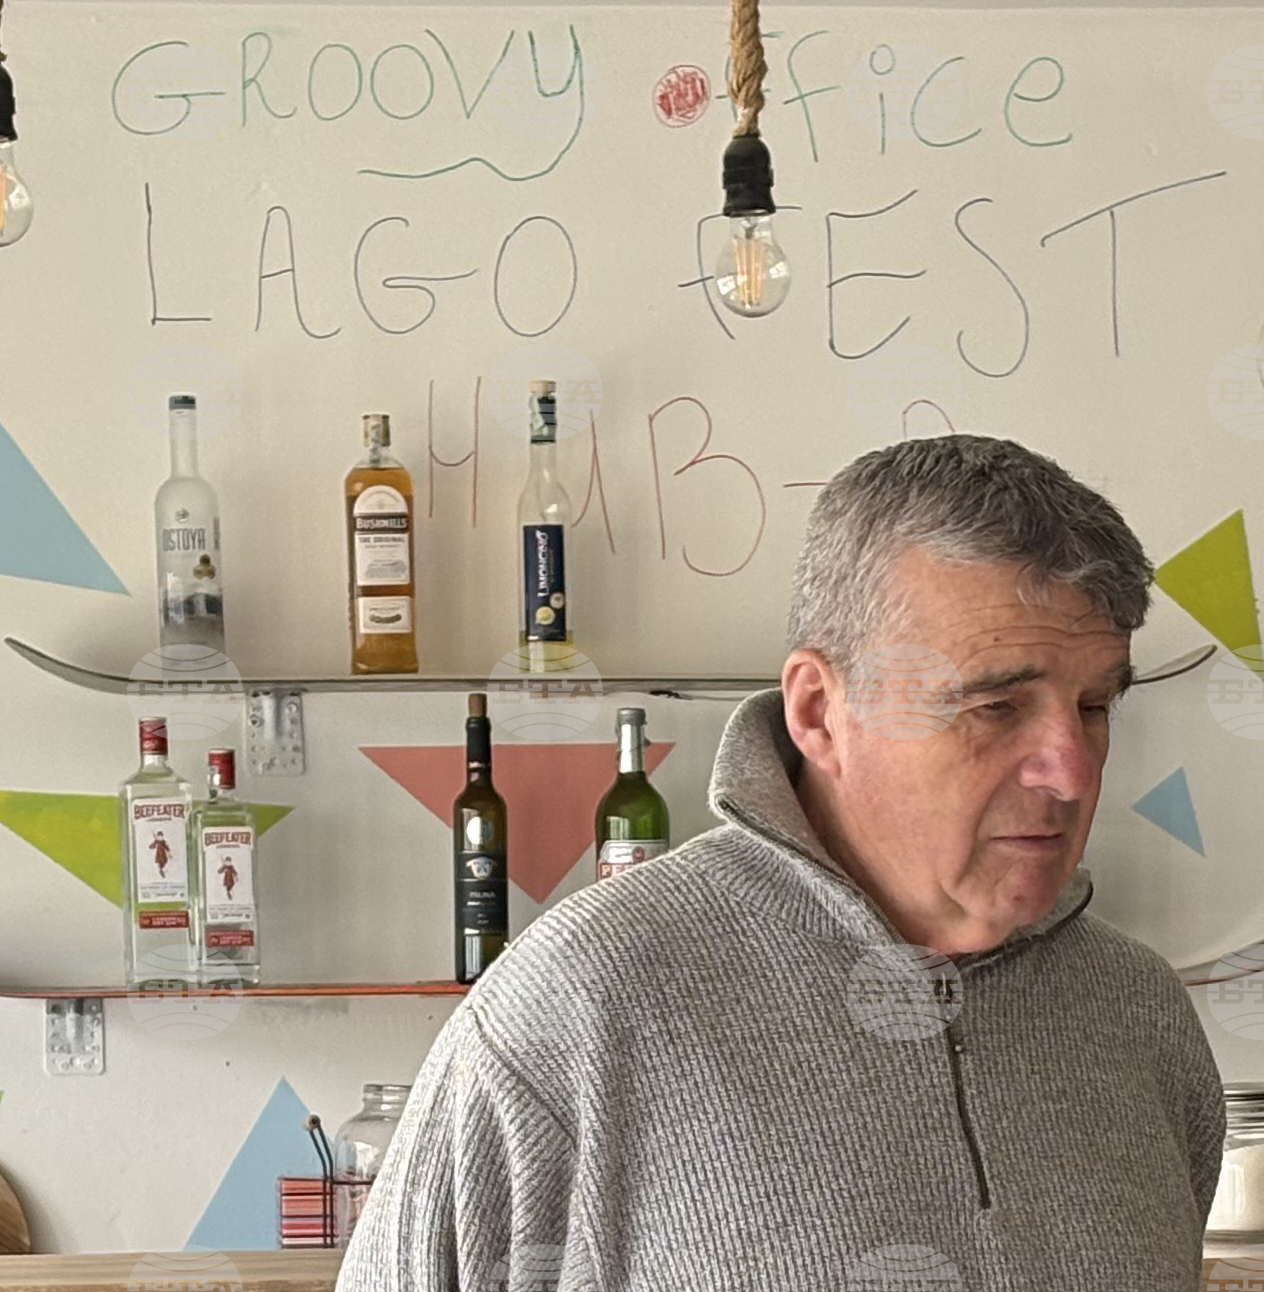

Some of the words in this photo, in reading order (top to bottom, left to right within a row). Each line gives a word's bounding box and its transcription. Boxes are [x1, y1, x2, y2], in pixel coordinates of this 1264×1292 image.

[144, 183, 579, 340] LAGO
[678, 171, 1228, 378] FEST
[134, 803, 185, 820] BEEFEATER
[204, 831, 252, 847] BEEFEATER
